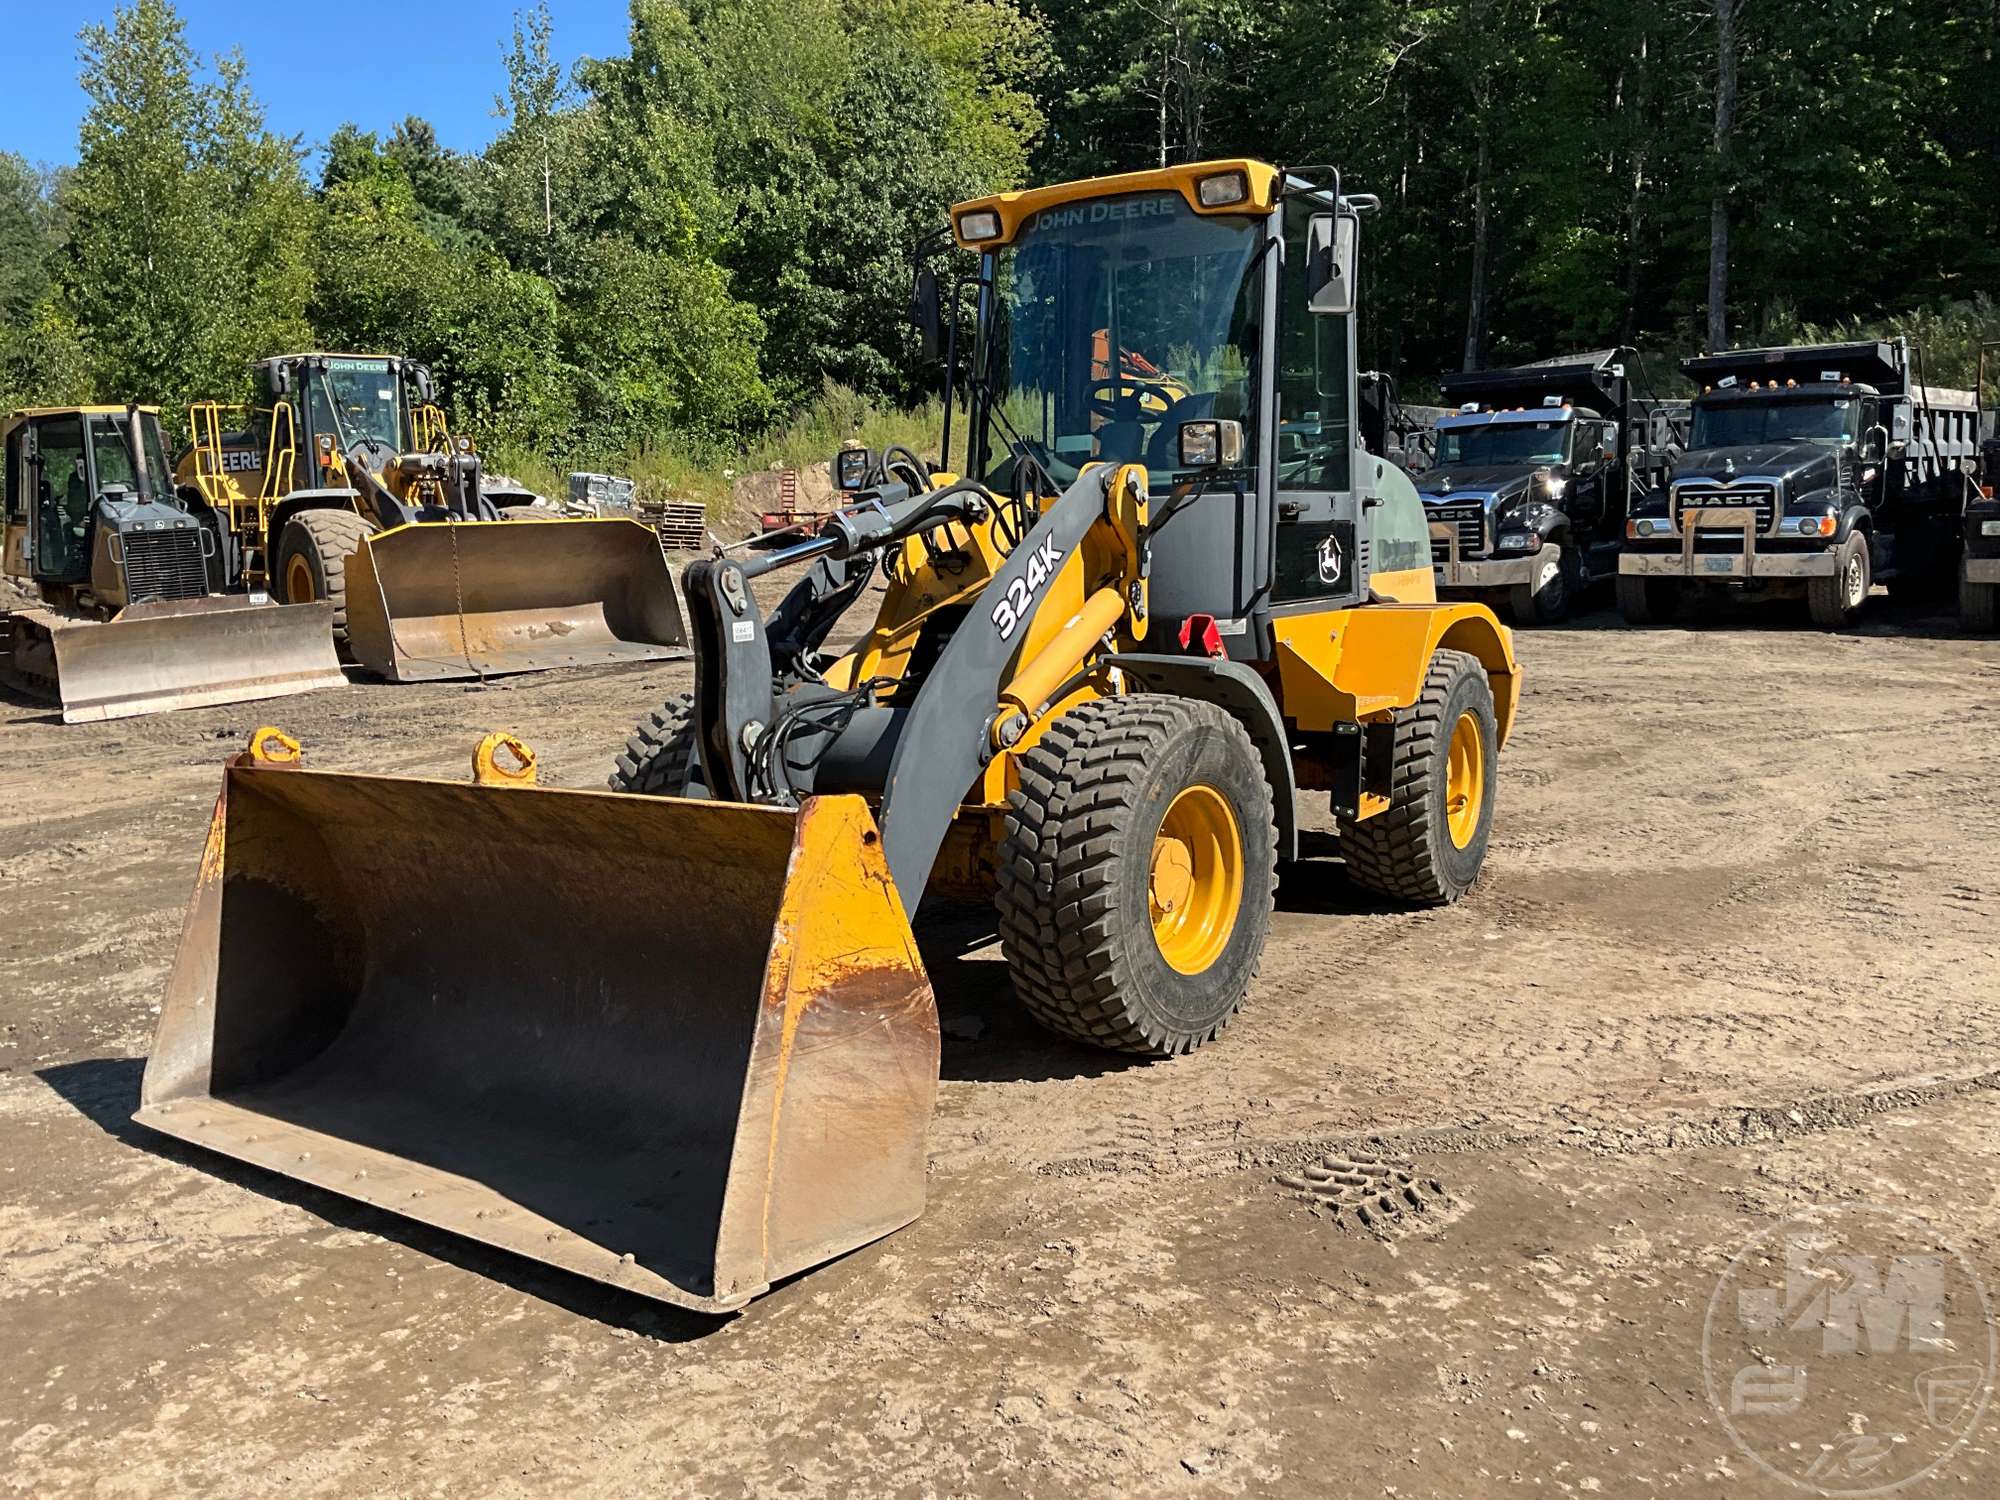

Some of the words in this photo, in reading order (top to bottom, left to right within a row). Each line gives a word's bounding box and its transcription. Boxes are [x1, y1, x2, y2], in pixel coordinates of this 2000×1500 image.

[1028, 208, 1085, 232] JOHN
[1090, 196, 1176, 223] DEERE
[329, 361, 354, 370] JOHN
[1682, 496, 1766, 506] MACK
[1427, 510, 1473, 519] ACK
[991, 528, 1065, 642] 324K
